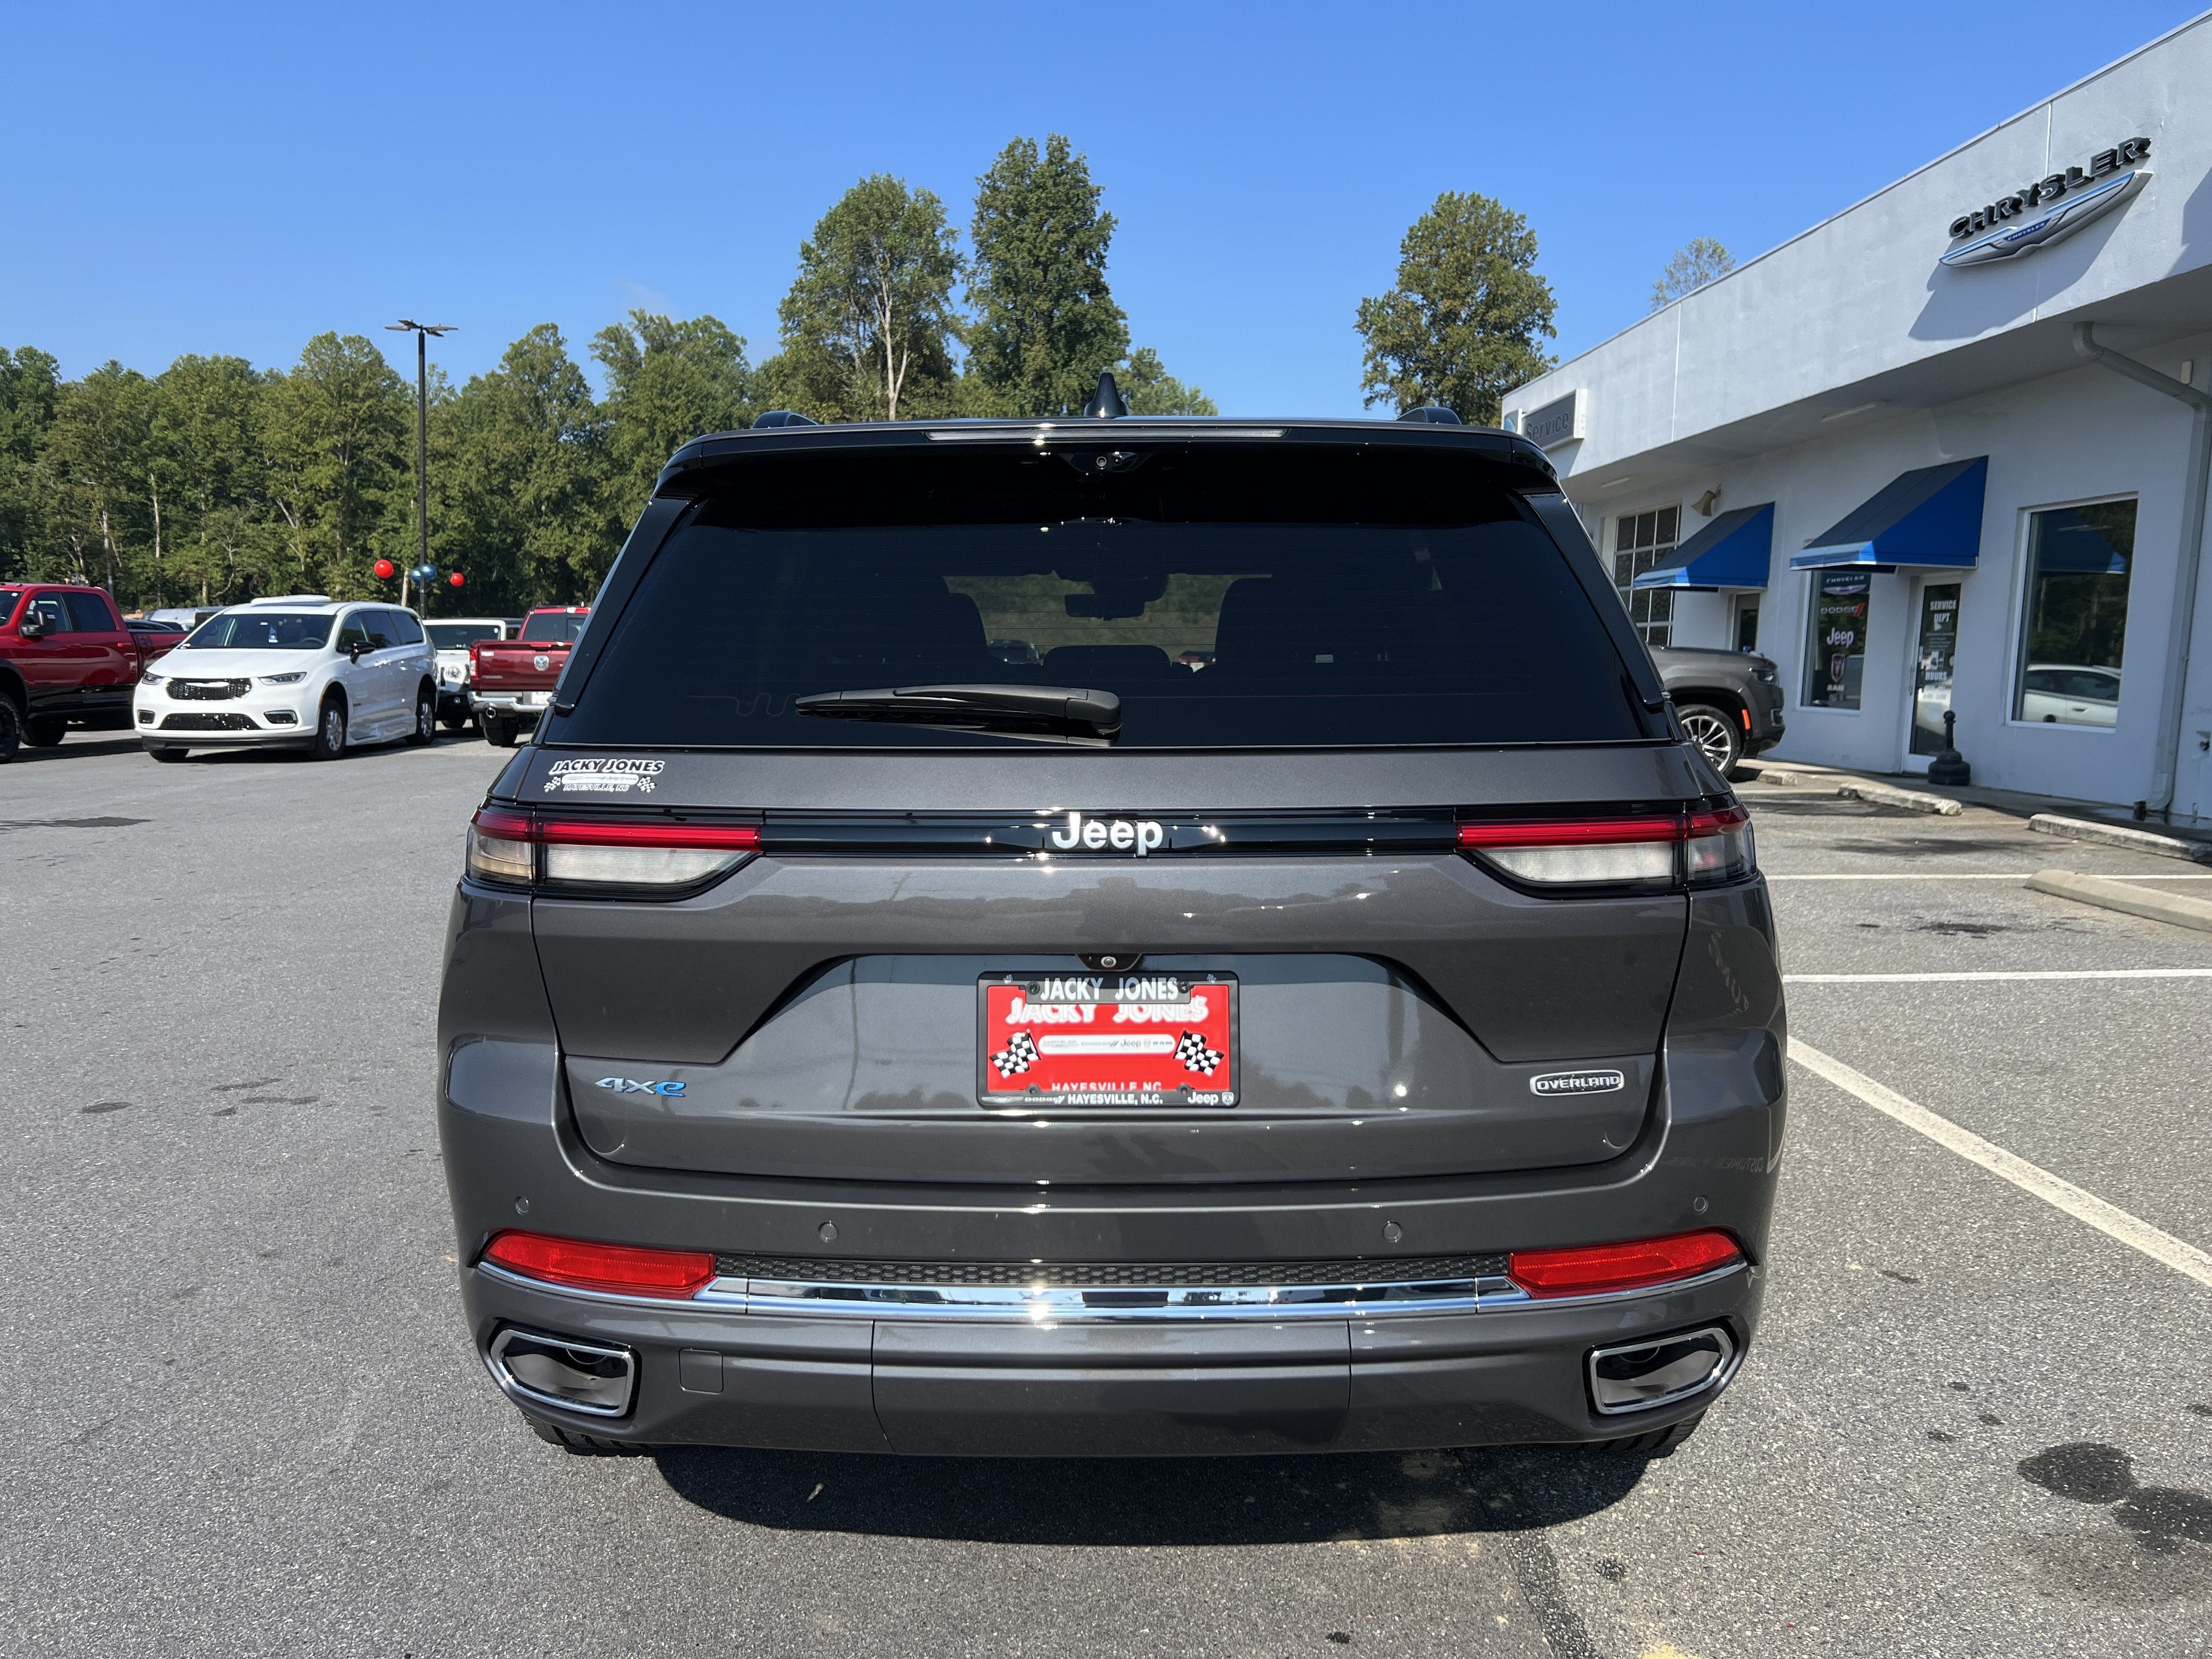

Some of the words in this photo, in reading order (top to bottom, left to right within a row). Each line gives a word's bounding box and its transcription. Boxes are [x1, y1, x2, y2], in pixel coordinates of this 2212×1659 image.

[1948, 137, 2151, 238] CHRYSLER
[1526, 411, 1569, 439] Service
[1821, 605, 1859, 614] DODGE
[1930, 600, 1957, 611] SERVICE
[1934, 613, 1951, 623] DEPT
[1827, 627, 1854, 648] Jeep
[1926, 672, 1947, 681] HOURS
[549, 759, 606, 775] JACKY
[602, 759, 665, 775] JONES
[1052, 812, 1163, 856] Jeep
[1041, 977, 1104, 1001] JACKY
[1115, 976, 1178, 1001] JONES
[1005, 996, 1098, 1024] JACKY
[1112, 994, 1209, 1024] JONES
[1120, 1039, 1142, 1048] Jeep
[1052, 1081, 1137, 1091] HAYESVILLE
[1143, 1081, 1162, 1091] NC
[1537, 1076, 1621, 1090] OVERLAND
[1068, 1093, 1138, 1105] HAYESVILLE,
[1141, 1093, 1163, 1104] N.C.
[1188, 1092, 1219, 1105] Jeep
